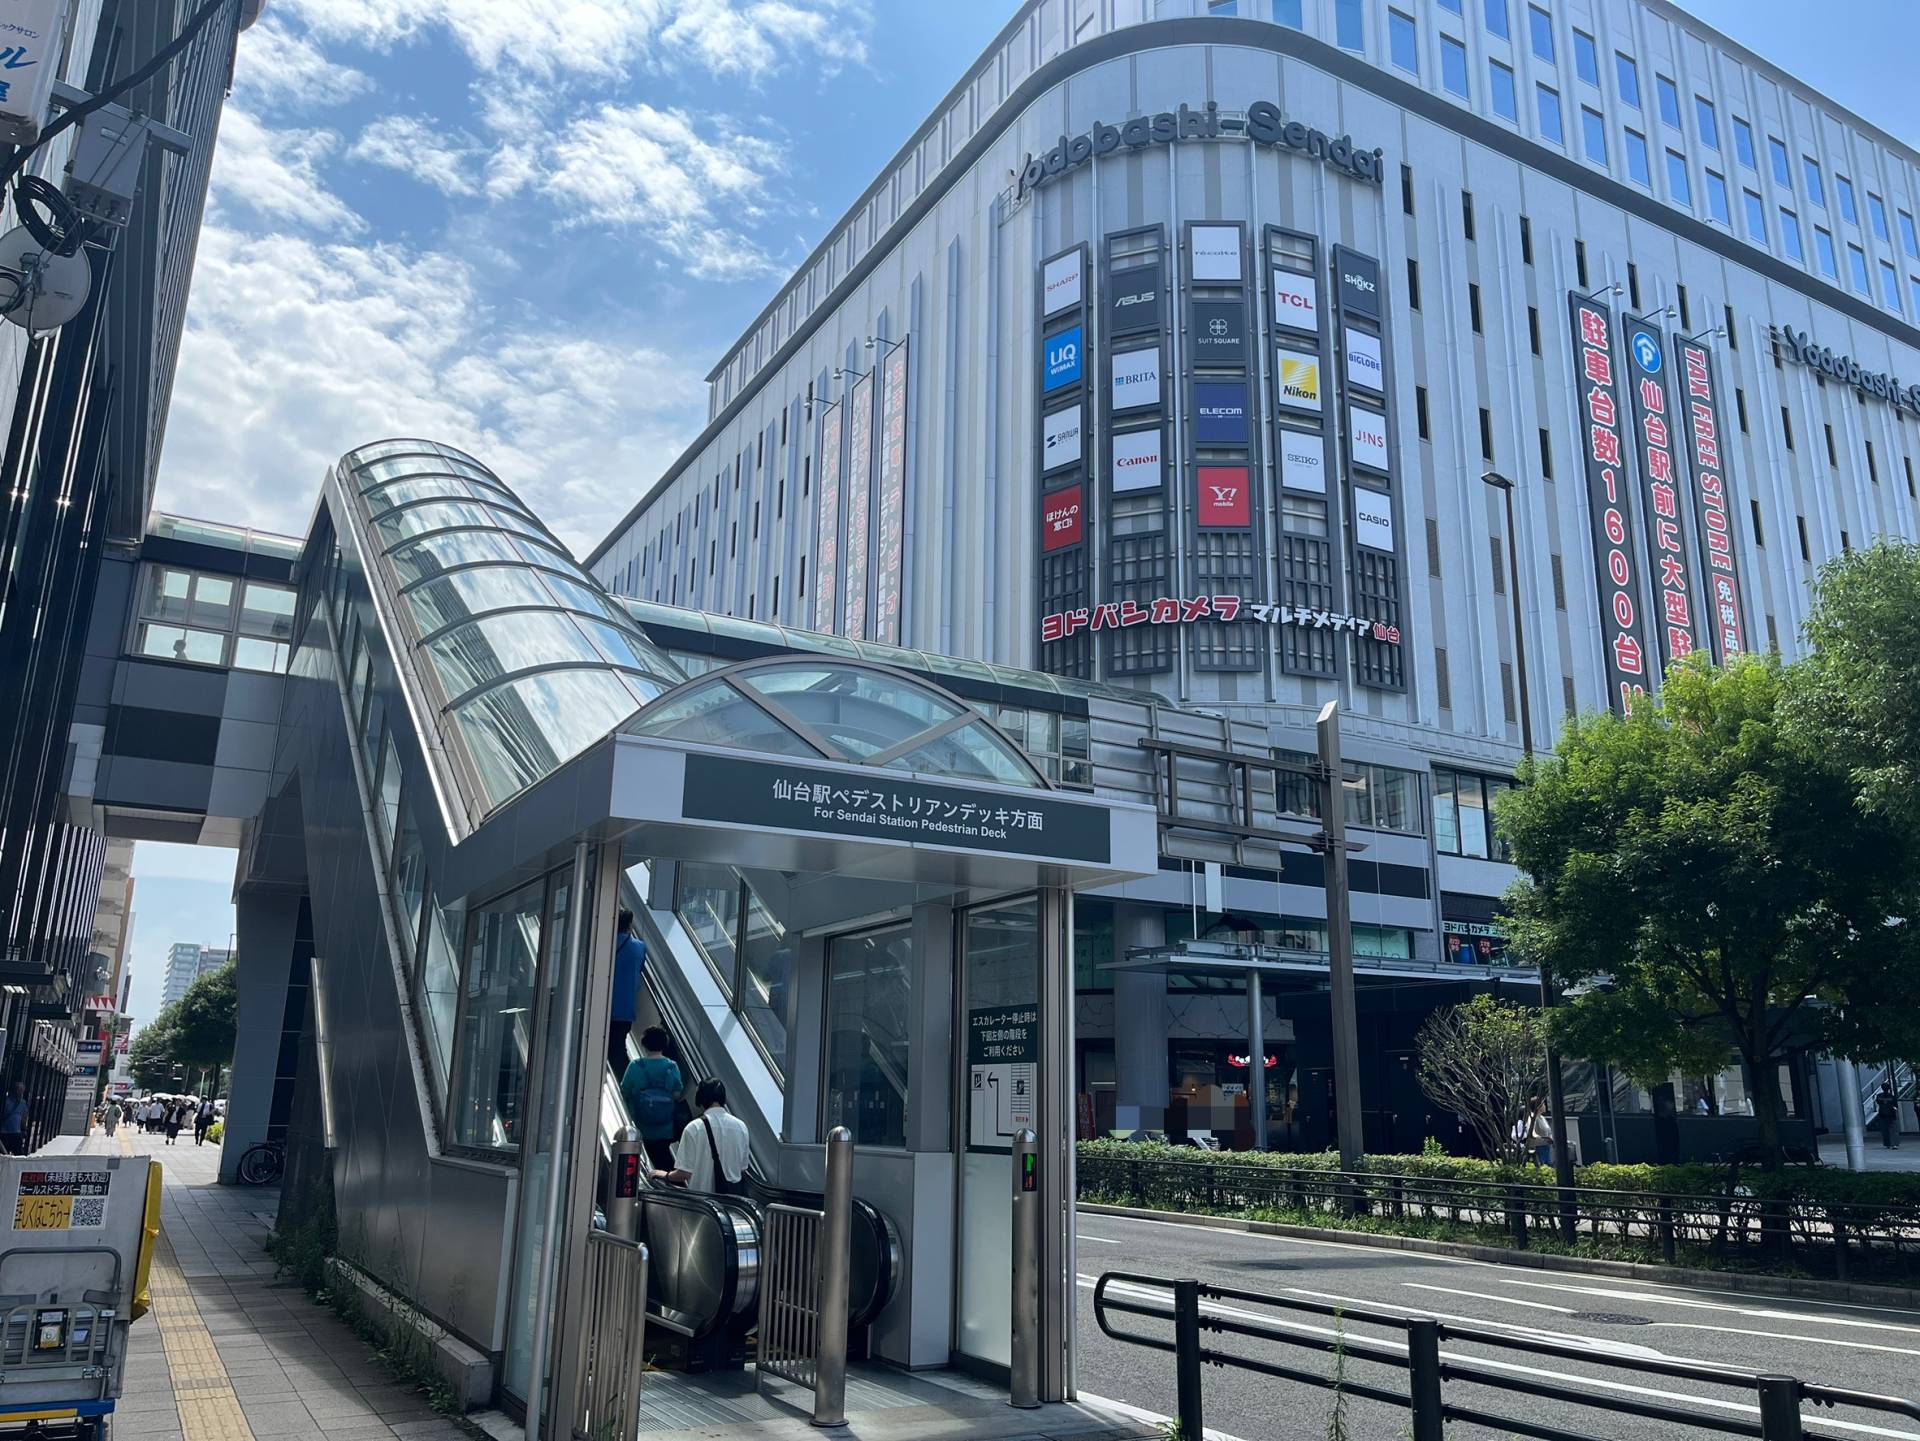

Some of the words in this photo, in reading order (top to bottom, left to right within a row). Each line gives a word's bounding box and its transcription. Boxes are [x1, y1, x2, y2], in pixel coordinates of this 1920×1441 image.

[1046, 273, 1079, 292] SHARP
[1344, 274, 1376, 293] SHOKZ
[1115, 292, 1155, 307] ASUS
[1278, 291, 1313, 310] TCL
[1050, 344, 1076, 366] UQ
[1348, 353, 1381, 371] BIGLOBE
[1126, 371, 1156, 385] BRITA
[1684, 347, 1711, 402] TAX
[1283, 385, 1317, 400] Nikon
[1200, 407, 1242, 415] ELECOM
[1691, 401, 1719, 470] FREE
[1116, 455, 1157, 467] Canon
[1287, 453, 1319, 466] SEIKO
[1209, 486, 1237, 501] Y!
[1046, 504, 1079, 523] ほけんの
[1359, 512, 1390, 527] CASIO
[1700, 472, 1732, 571] STORE
[1042, 595, 1241, 642] ヨドバシカメラ
[1717, 580, 1740, 664] 免税品
[772, 779, 1043, 831] 仙台駅ペデストリアンデッキ方面
[814, 806, 834, 819] For
[836, 809, 876, 824] Sendai
[879, 814, 918, 829] Station
[921, 819, 978, 836] Pedestrian
[981, 826, 1007, 839] Deck
